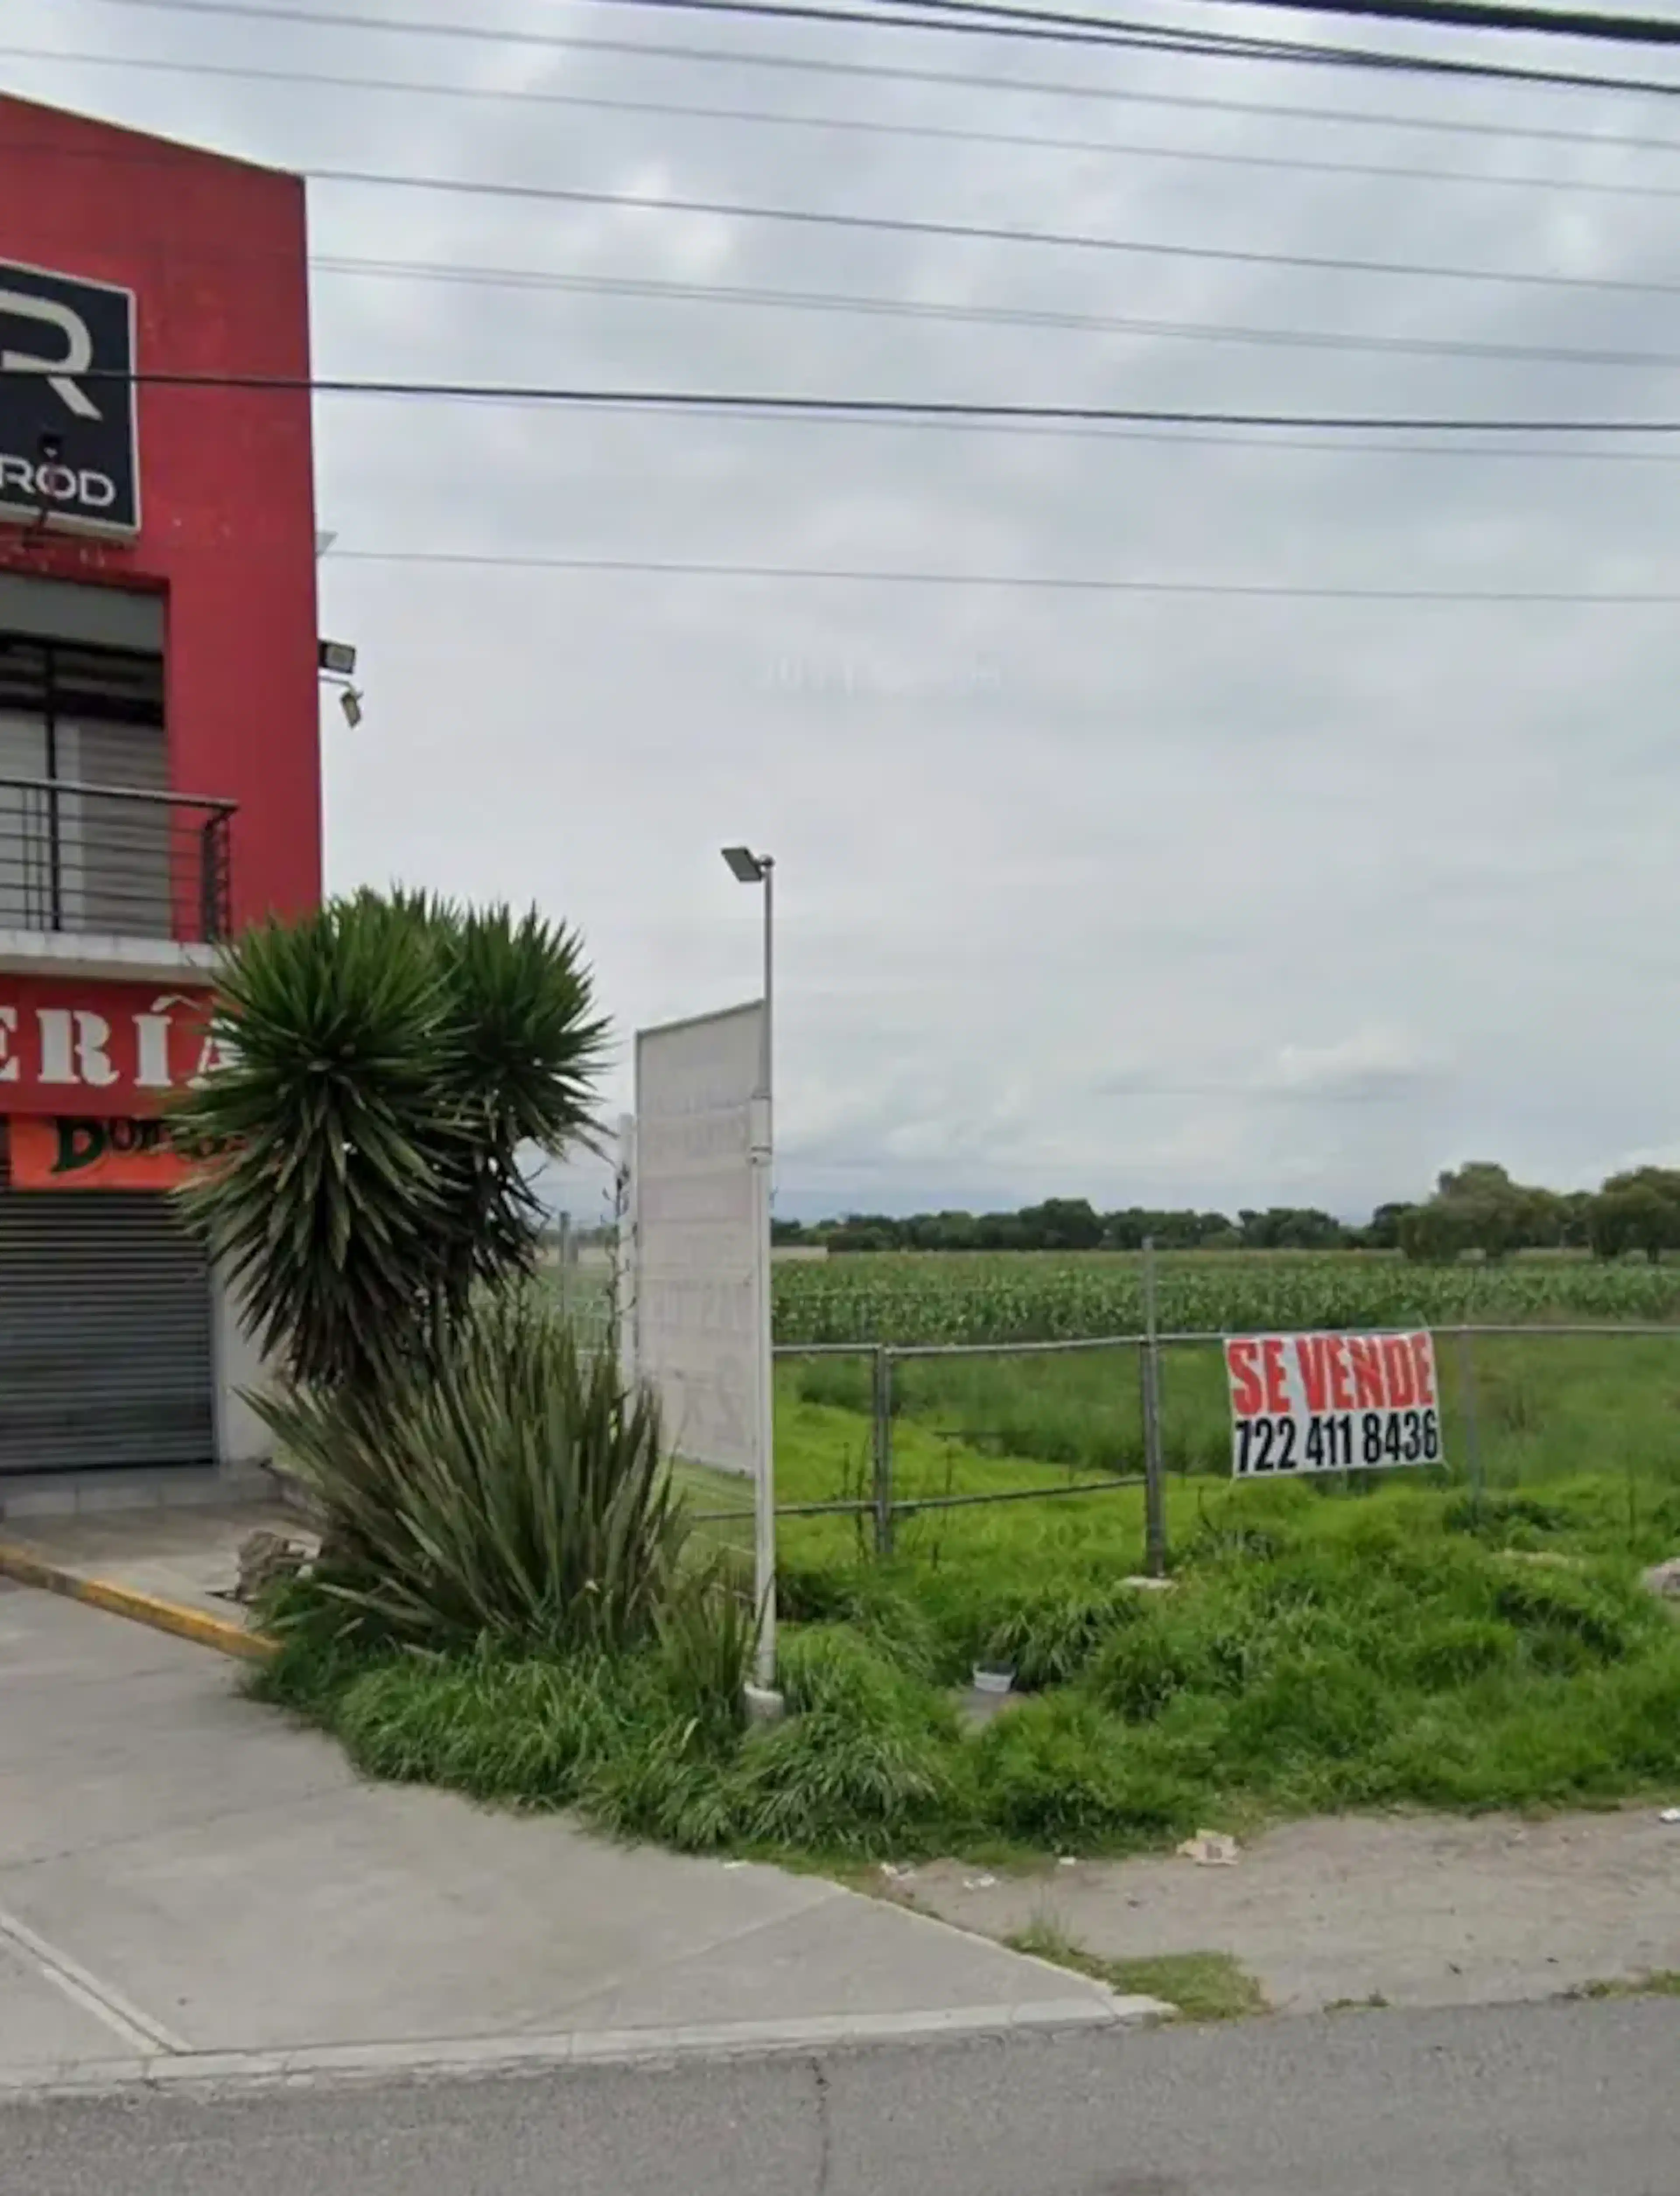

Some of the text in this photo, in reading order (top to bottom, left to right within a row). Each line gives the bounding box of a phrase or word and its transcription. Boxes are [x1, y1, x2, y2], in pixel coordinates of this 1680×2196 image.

[1228, 1331, 1433, 1415] SE VENDE
[1236, 1408, 1438, 1472] 722 411 8436
